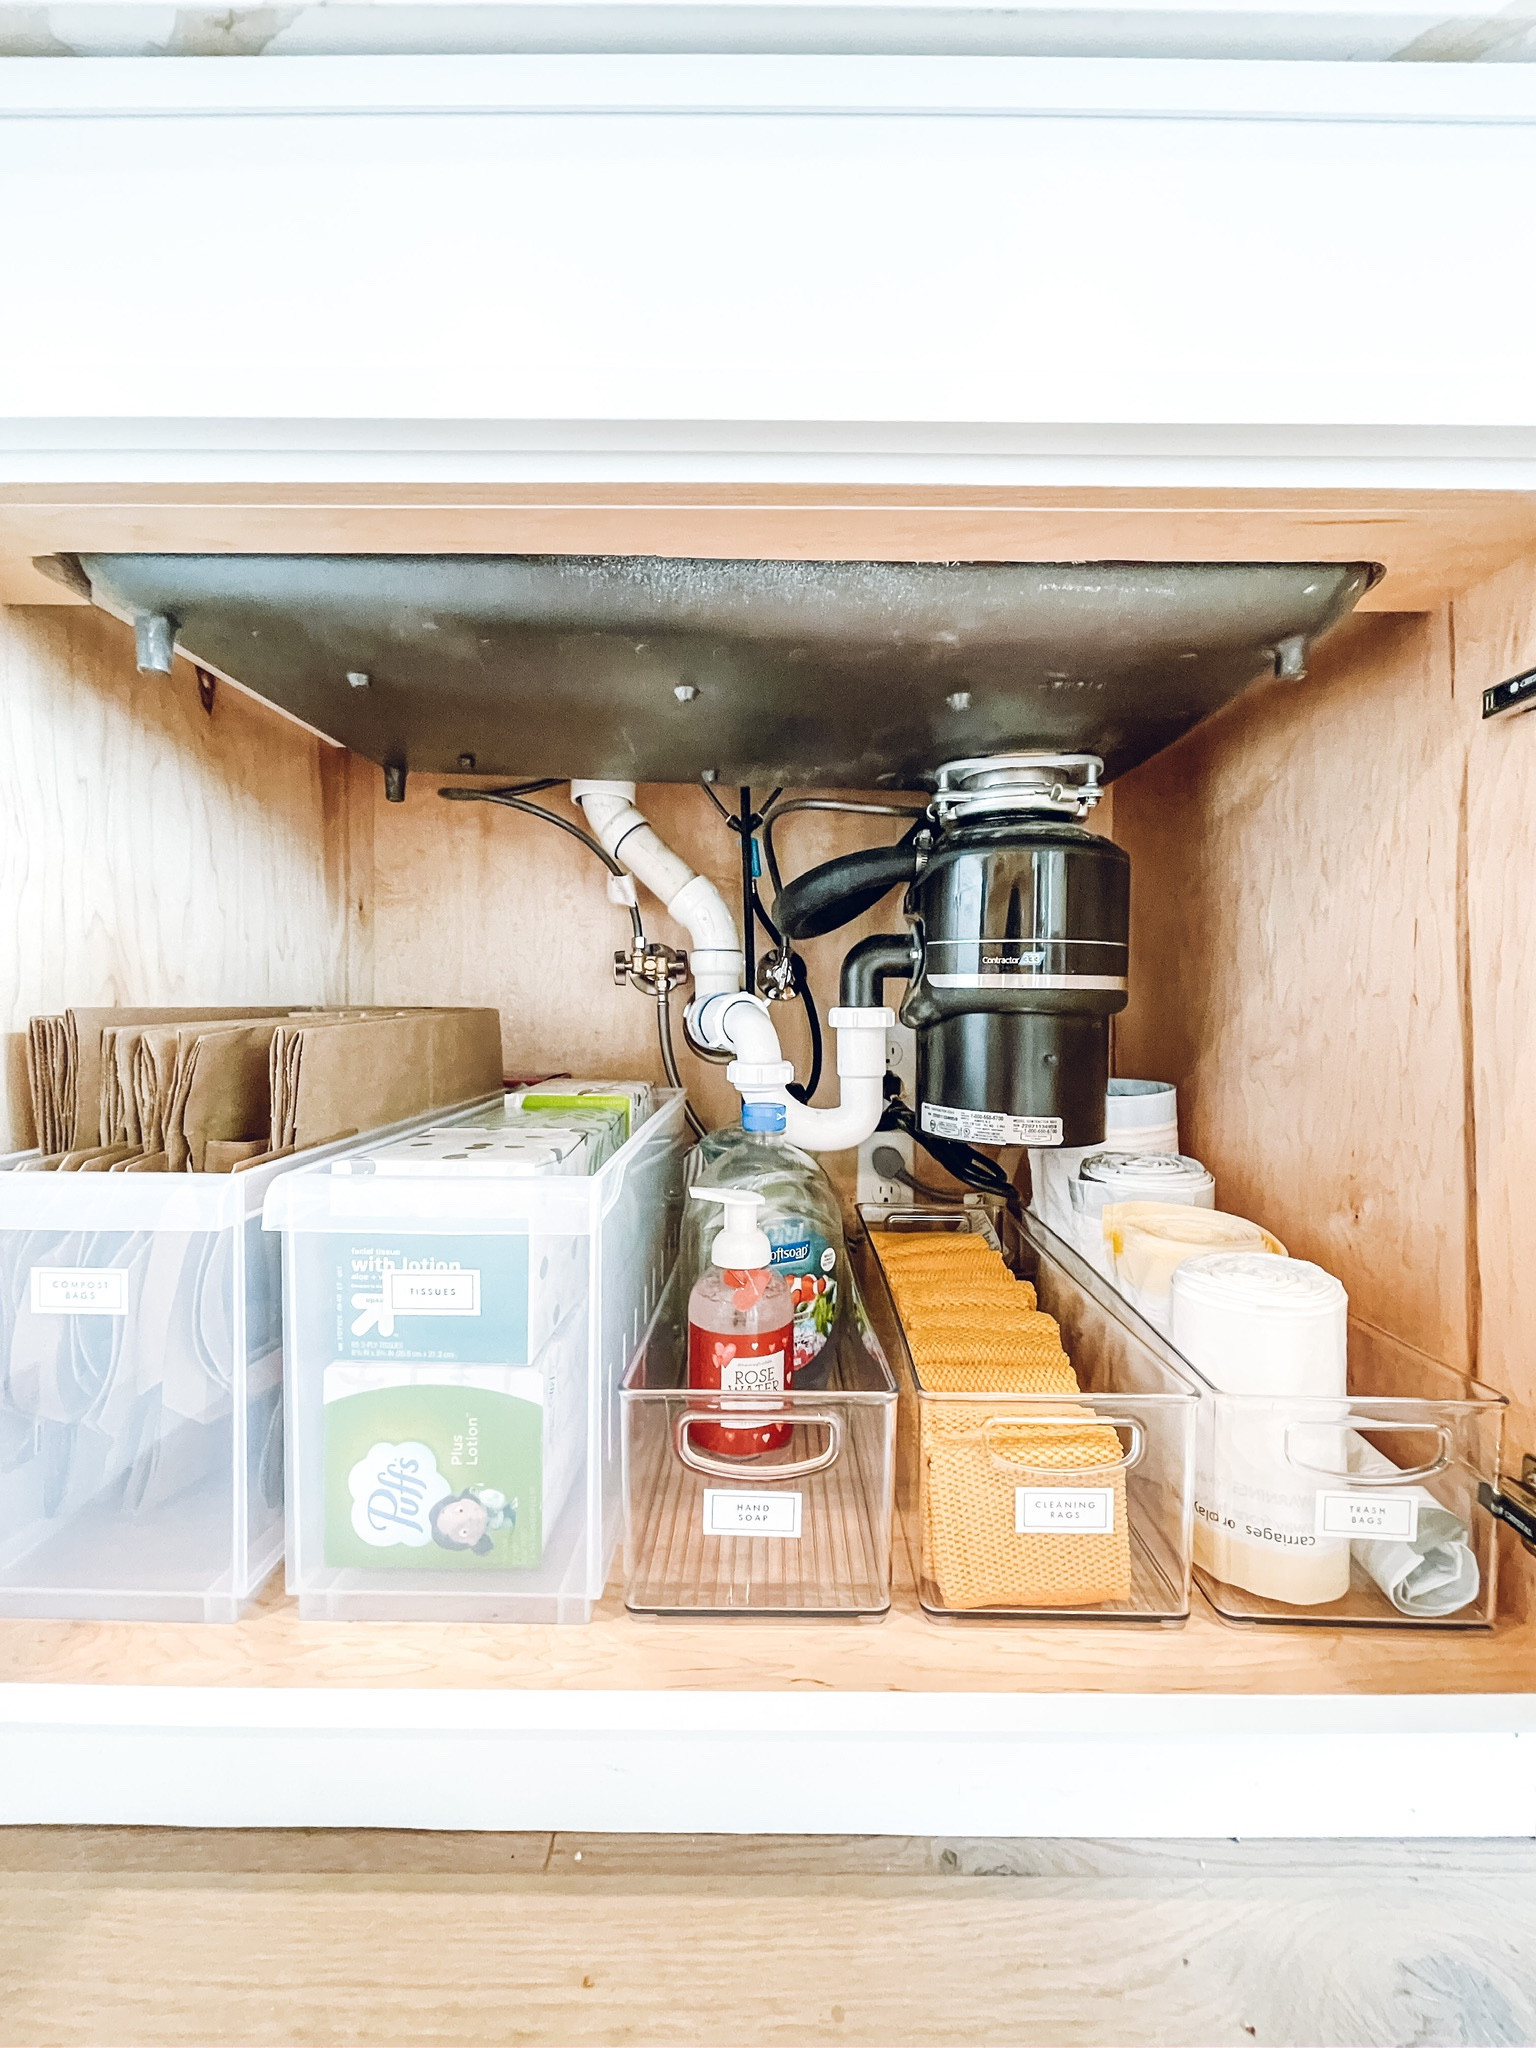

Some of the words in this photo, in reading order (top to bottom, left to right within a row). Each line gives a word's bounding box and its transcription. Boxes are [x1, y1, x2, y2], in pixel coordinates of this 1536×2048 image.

[982, 956, 1020, 965] Contractor
[1023, 955, 1041, 964] 333
[771, 1245, 808, 1263] oftsoap
[351, 1256, 396, 1273] with
[402, 1256, 461, 1271] lotion
[52, 1280, 109, 1289] COMPOST
[65, 1291, 96, 1300] BAGS
[410, 1287, 457, 1296] TISSUES
[735, 1366, 775, 1385] ROSE
[465, 1414, 479, 1467] Lotion
[450, 1434, 463, 1467] Plus
[367, 1456, 428, 1534] Puffs
[737, 1504, 770, 1512] HAND
[1034, 1501, 1097, 1510] CLEANING
[1349, 1505, 1387, 1515] TRASH
[738, 1514, 768, 1522] SOAP
[1050, 1511, 1081, 1520] RAGS
[1351, 1516, 1383, 1525] BAGS
[1223, 1517, 1236, 1529] or
[1245, 1525, 1316, 1547] carriages
